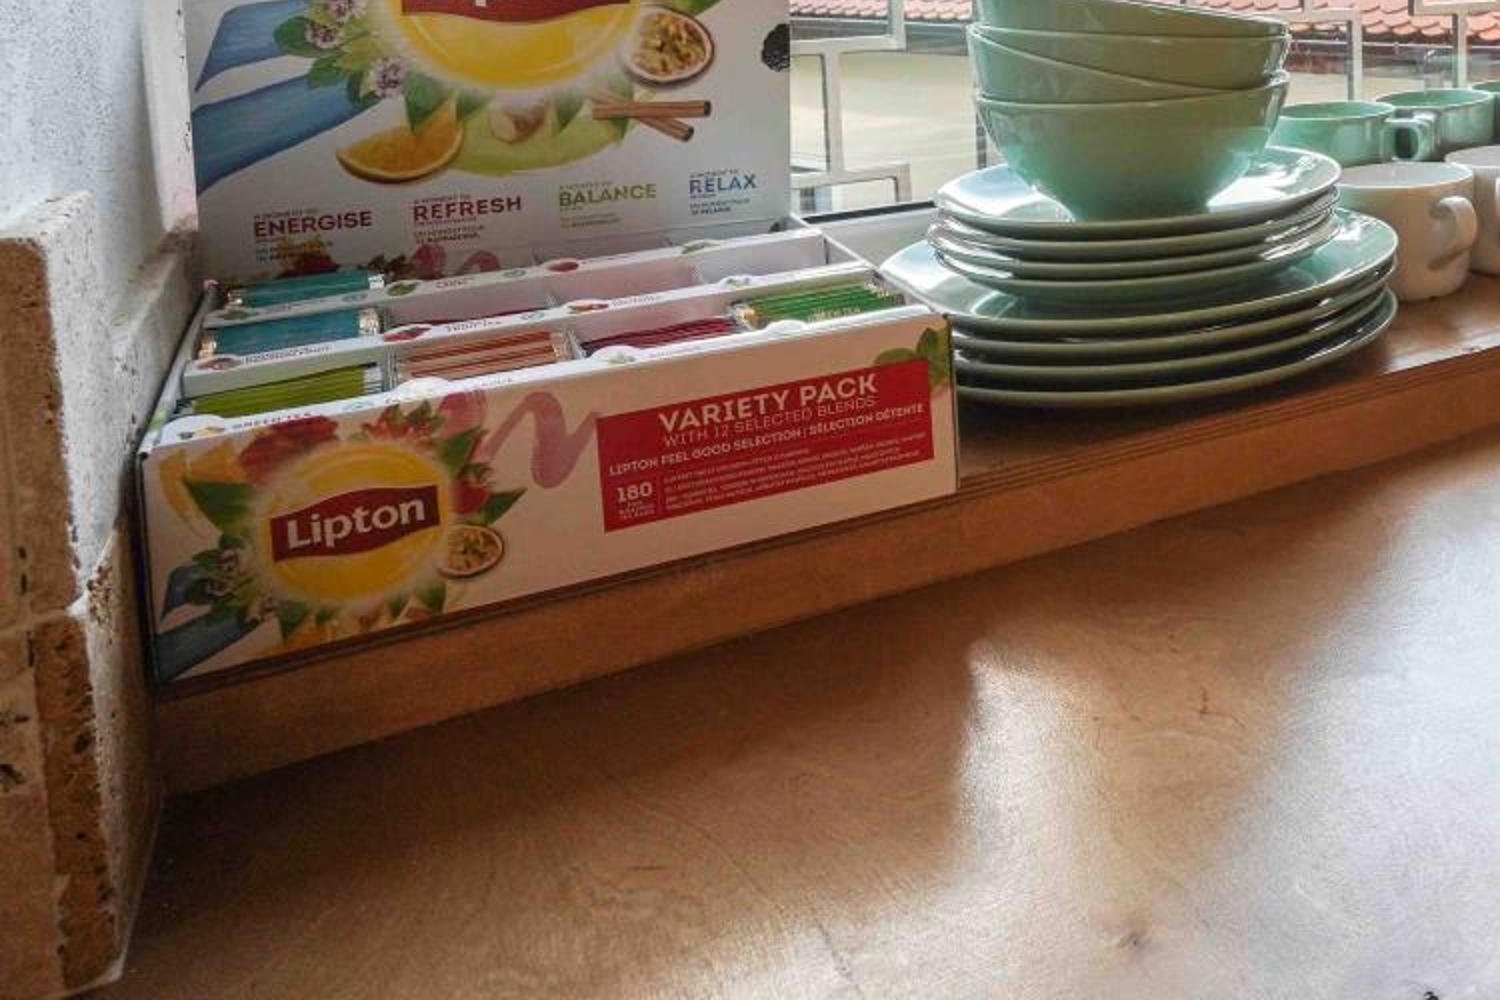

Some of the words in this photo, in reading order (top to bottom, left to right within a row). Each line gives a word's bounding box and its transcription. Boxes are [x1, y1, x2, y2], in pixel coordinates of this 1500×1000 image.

[560, 184, 656, 206] BALANCE
[689, 174, 757, 194] RELAX
[414, 196, 522, 221] REFRESH
[254, 211, 372, 237] ENERGISE
[659, 390, 789, 432] VARIETY
[800, 373, 878, 405] PACK
[663, 428, 707, 447] WITH
[714, 424, 729, 439] 12
[735, 408, 813, 433] SELECTED
[817, 397, 876, 417] BLENDS
[609, 456, 658, 476] LIPTON
[661, 451, 691, 466] FEEL
[692, 443, 731, 457] GOOD
[733, 430, 800, 449] SELECTION
[616, 481, 654, 501] 180
[287, 498, 425, 549] Lipton
